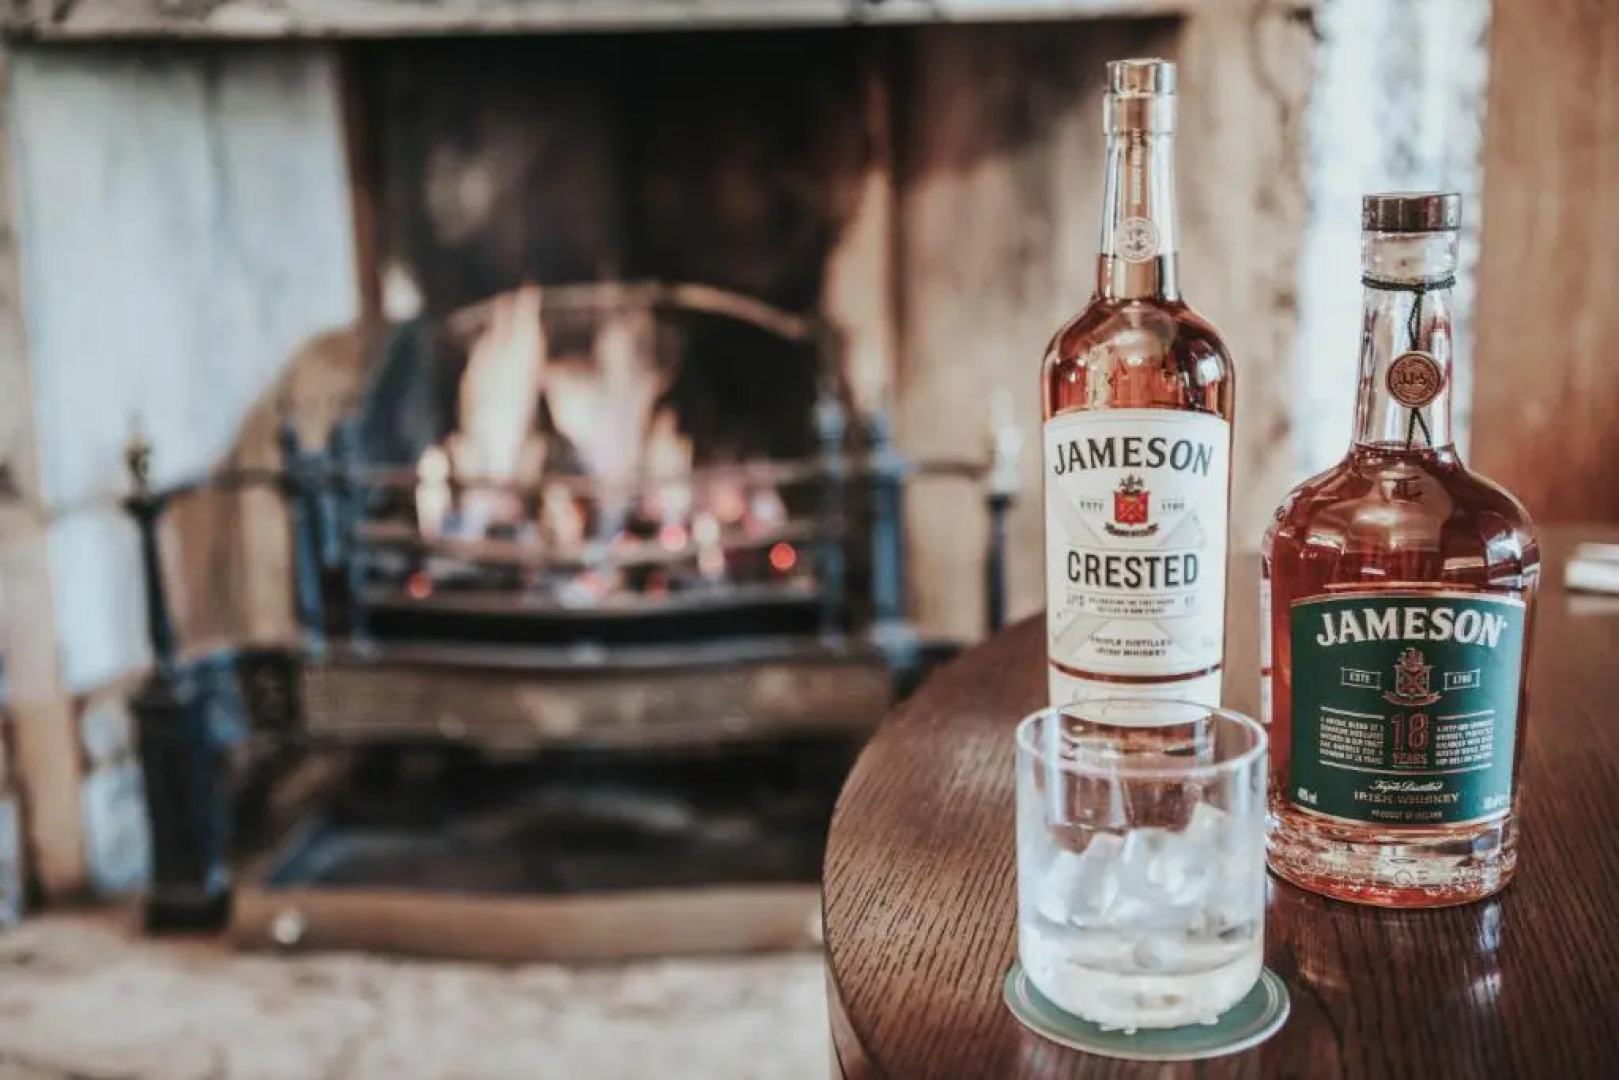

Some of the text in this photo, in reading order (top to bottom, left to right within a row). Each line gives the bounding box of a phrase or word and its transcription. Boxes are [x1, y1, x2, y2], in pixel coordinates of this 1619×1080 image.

[1054, 436, 1214, 476] JAMESON
[1067, 550, 1198, 589] CRESTED
[1316, 606, 1503, 648] JAMESON
[1390, 713, 1429, 751] 18
[1392, 752, 1428, 765] YEARS
[1354, 790, 1459, 804] IRISH WHISKEY
